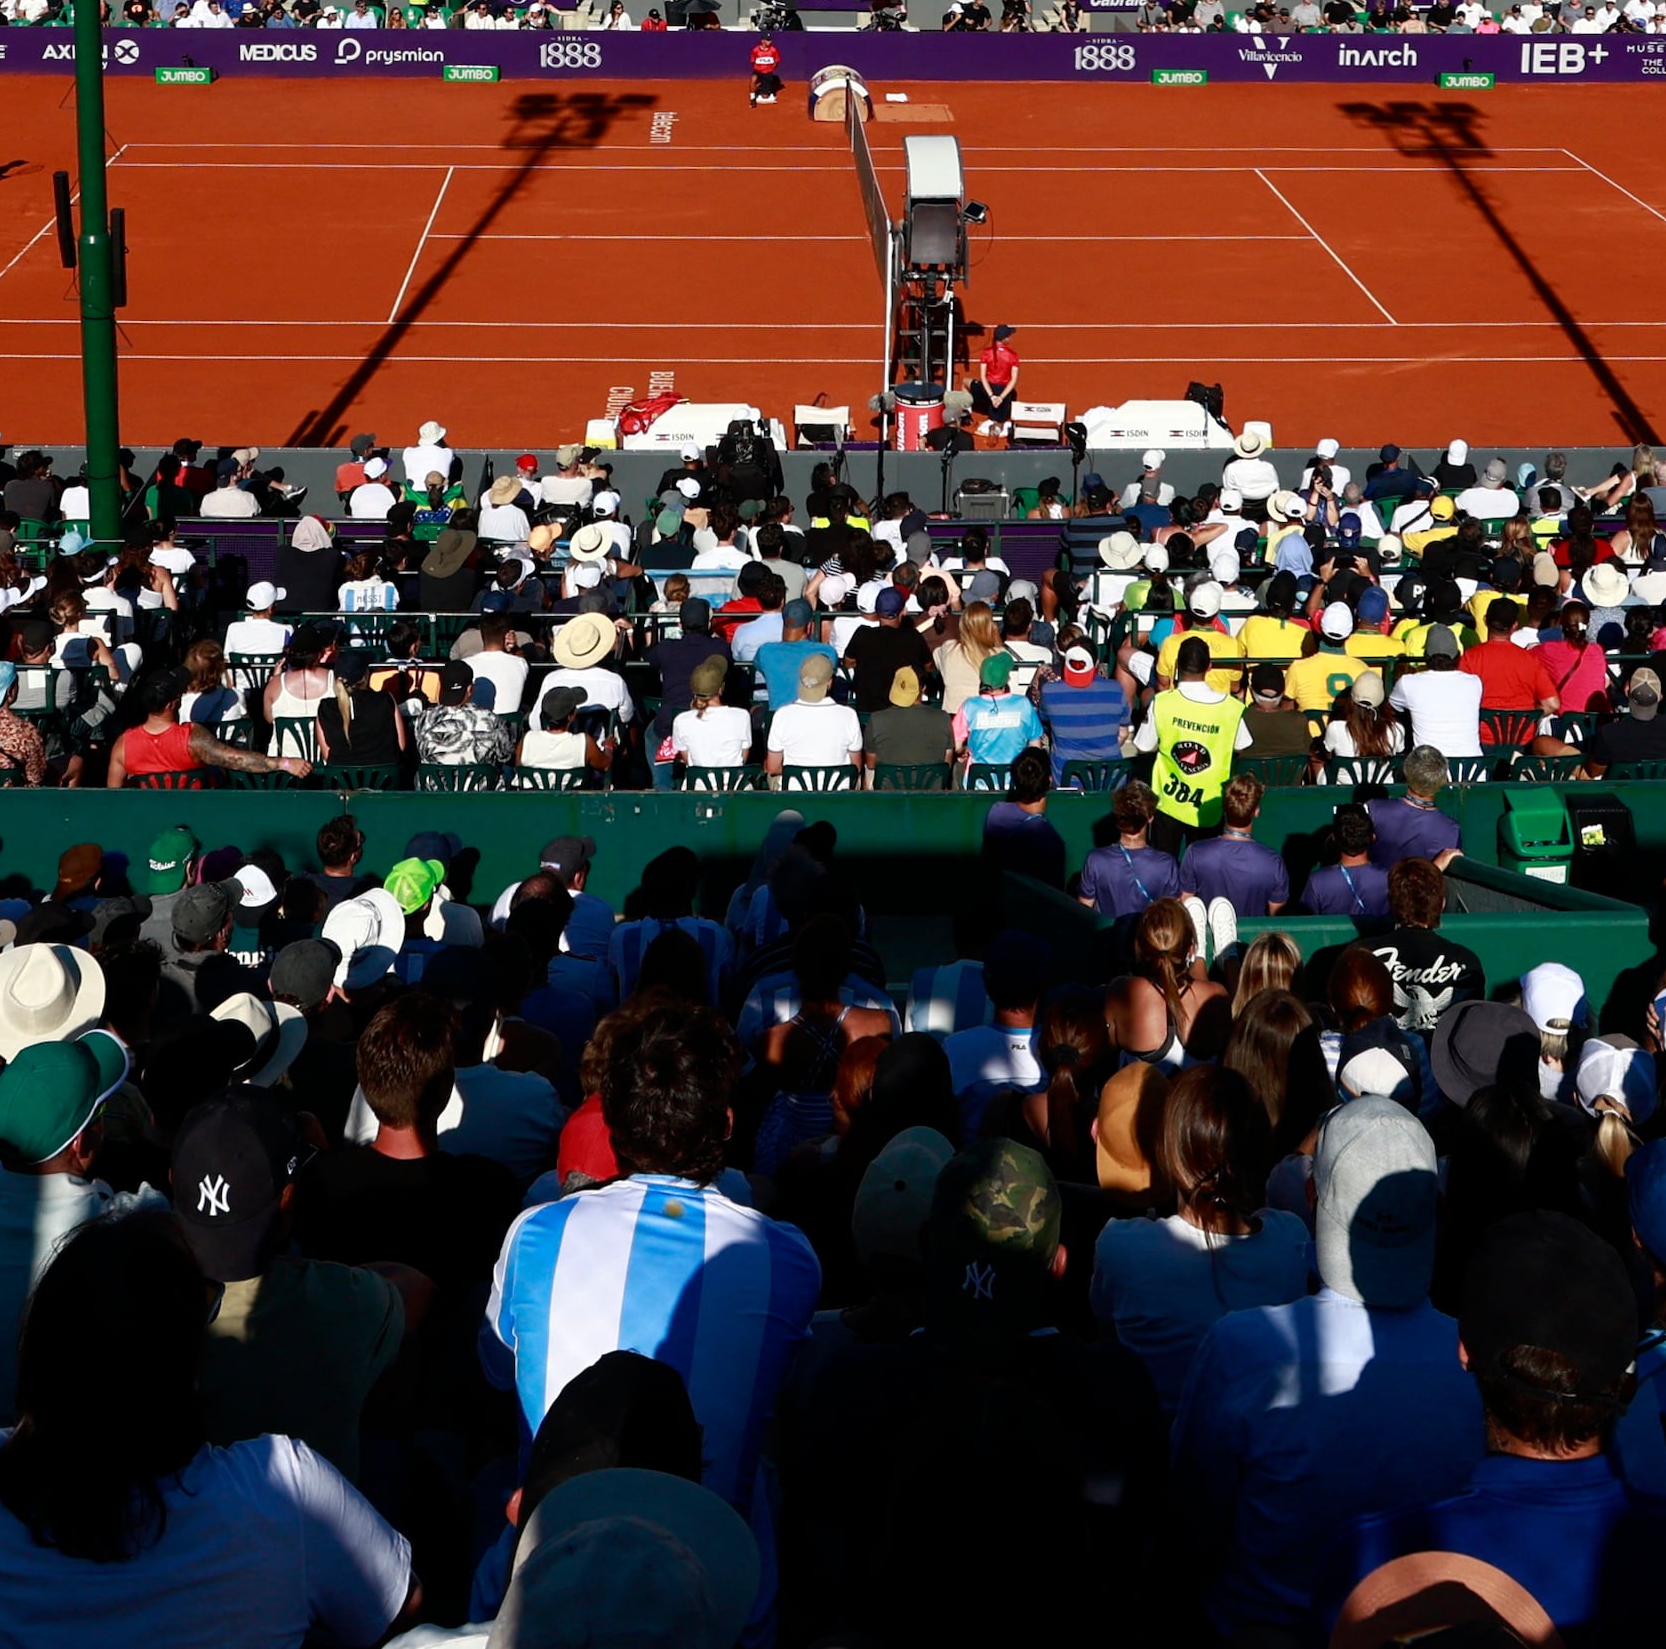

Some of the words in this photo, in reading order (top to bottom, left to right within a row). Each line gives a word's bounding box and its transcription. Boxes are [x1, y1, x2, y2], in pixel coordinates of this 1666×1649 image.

[239, 44, 317, 61] MEDICUS
[365, 47, 444, 65] prysmian
[539, 42, 602, 69] 1888
[1074, 44, 1136, 71] 1888
[1238, 48, 1303, 63] Villavicencio
[1520, 42, 1609, 74] IEB+
[1642, 58, 1663, 66] THE
[161, 70, 206, 82] JUMBO
[448, 68, 493, 80] JUMBO
[1158, 72, 1203, 83] JUMBO
[1445, 76, 1490, 87] JUMBO
[672, 432, 694, 441] ISDIN
[1126, 429, 1149, 438] ISDIN
[1163, 772, 1204, 809] 384
[1372, 945, 1467, 985] Fender
